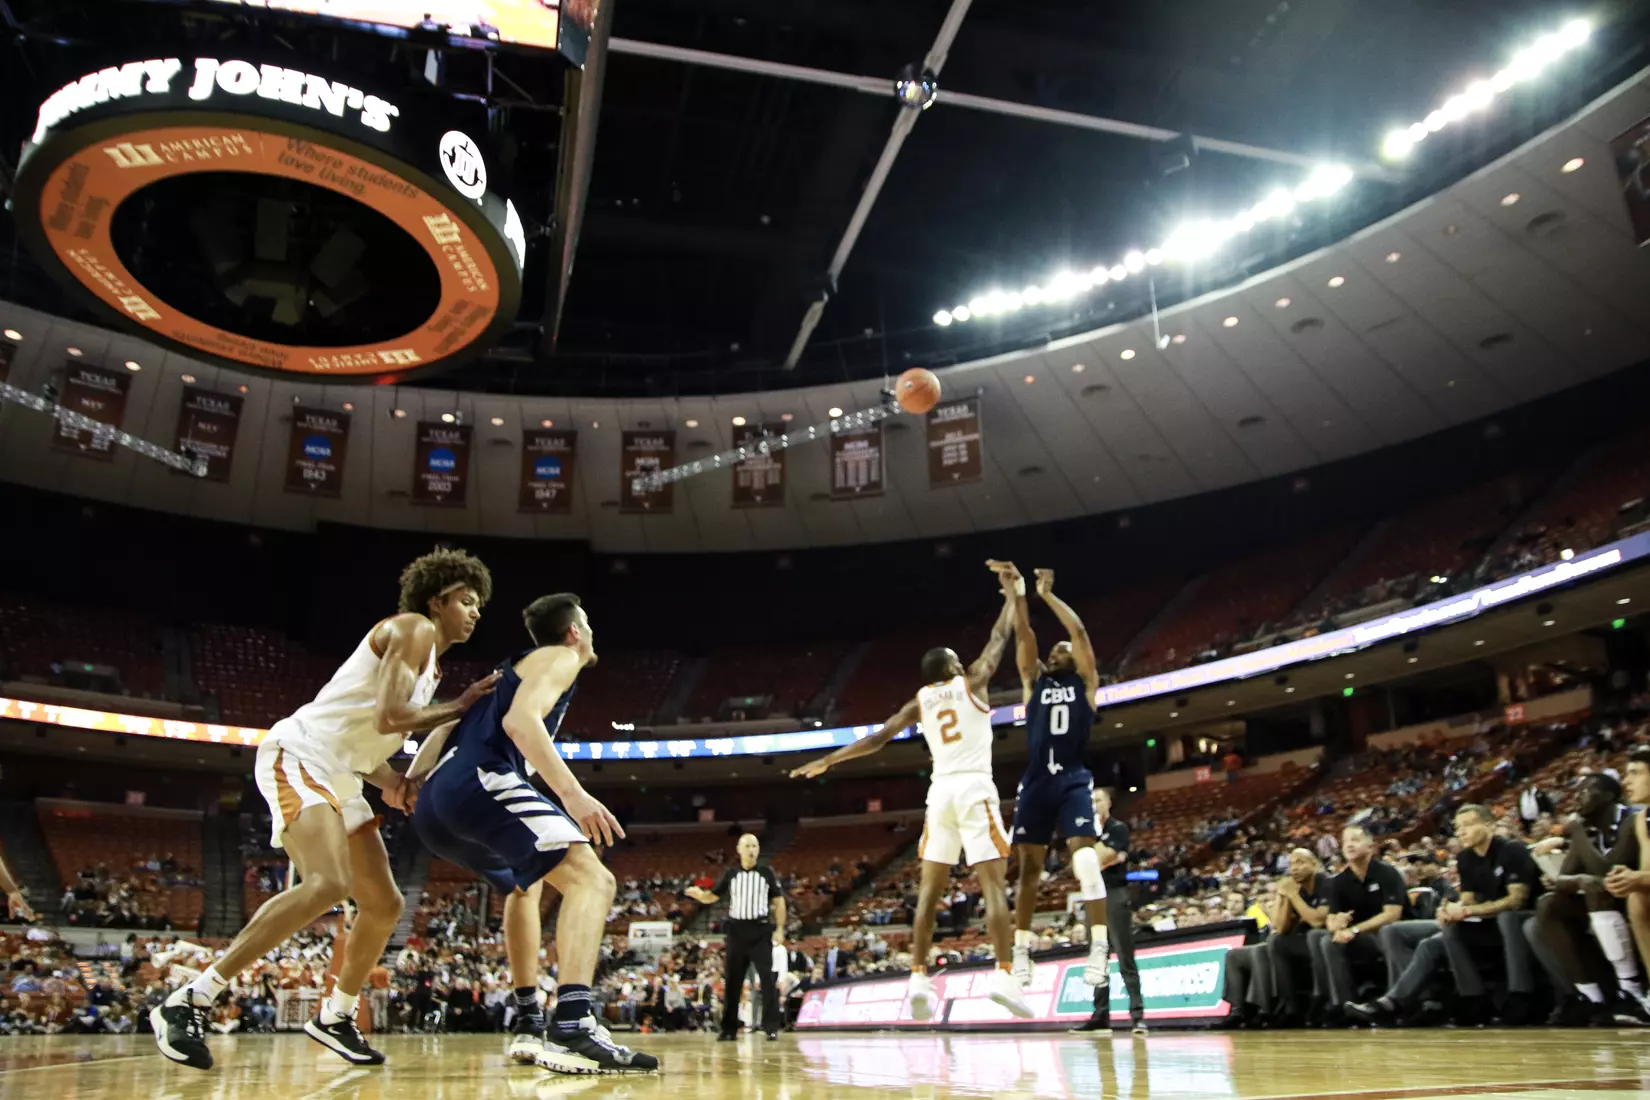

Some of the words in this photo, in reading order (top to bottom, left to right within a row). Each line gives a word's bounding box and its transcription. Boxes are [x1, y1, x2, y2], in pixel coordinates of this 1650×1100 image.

[188, 57, 399, 132] JOHN'S
[160, 133, 245, 153] AMERICAN
[166, 144, 253, 163] CAMPUS
[278, 150, 315, 173] love
[346, 164, 419, 198] students
[1041, 686, 1076, 704] CBU
[936, 708, 963, 744] 2
[1050, 704, 1070, 735] 0
